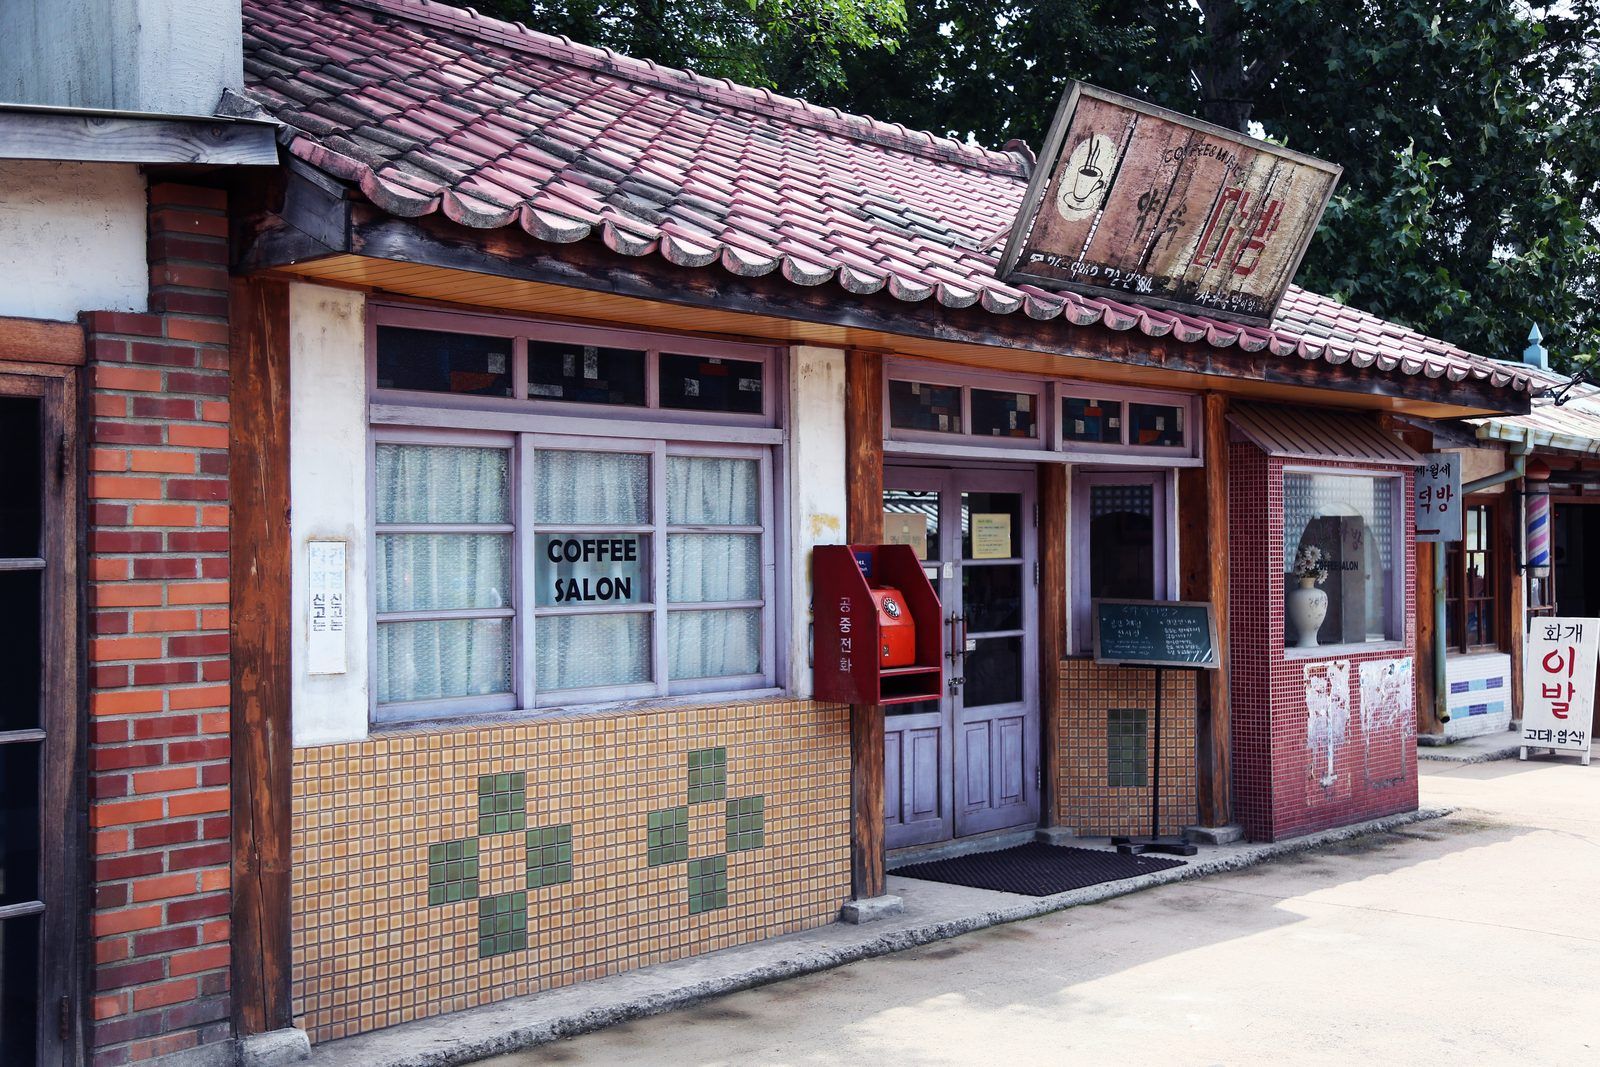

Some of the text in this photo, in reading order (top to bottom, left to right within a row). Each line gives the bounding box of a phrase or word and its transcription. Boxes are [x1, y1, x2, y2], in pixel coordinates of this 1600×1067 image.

[548, 538, 637, 563] COFFEE
[554, 576, 632, 603] SALON
[1543, 623, 1583, 643] 화개
[1541, 646, 1577, 720] 이발
